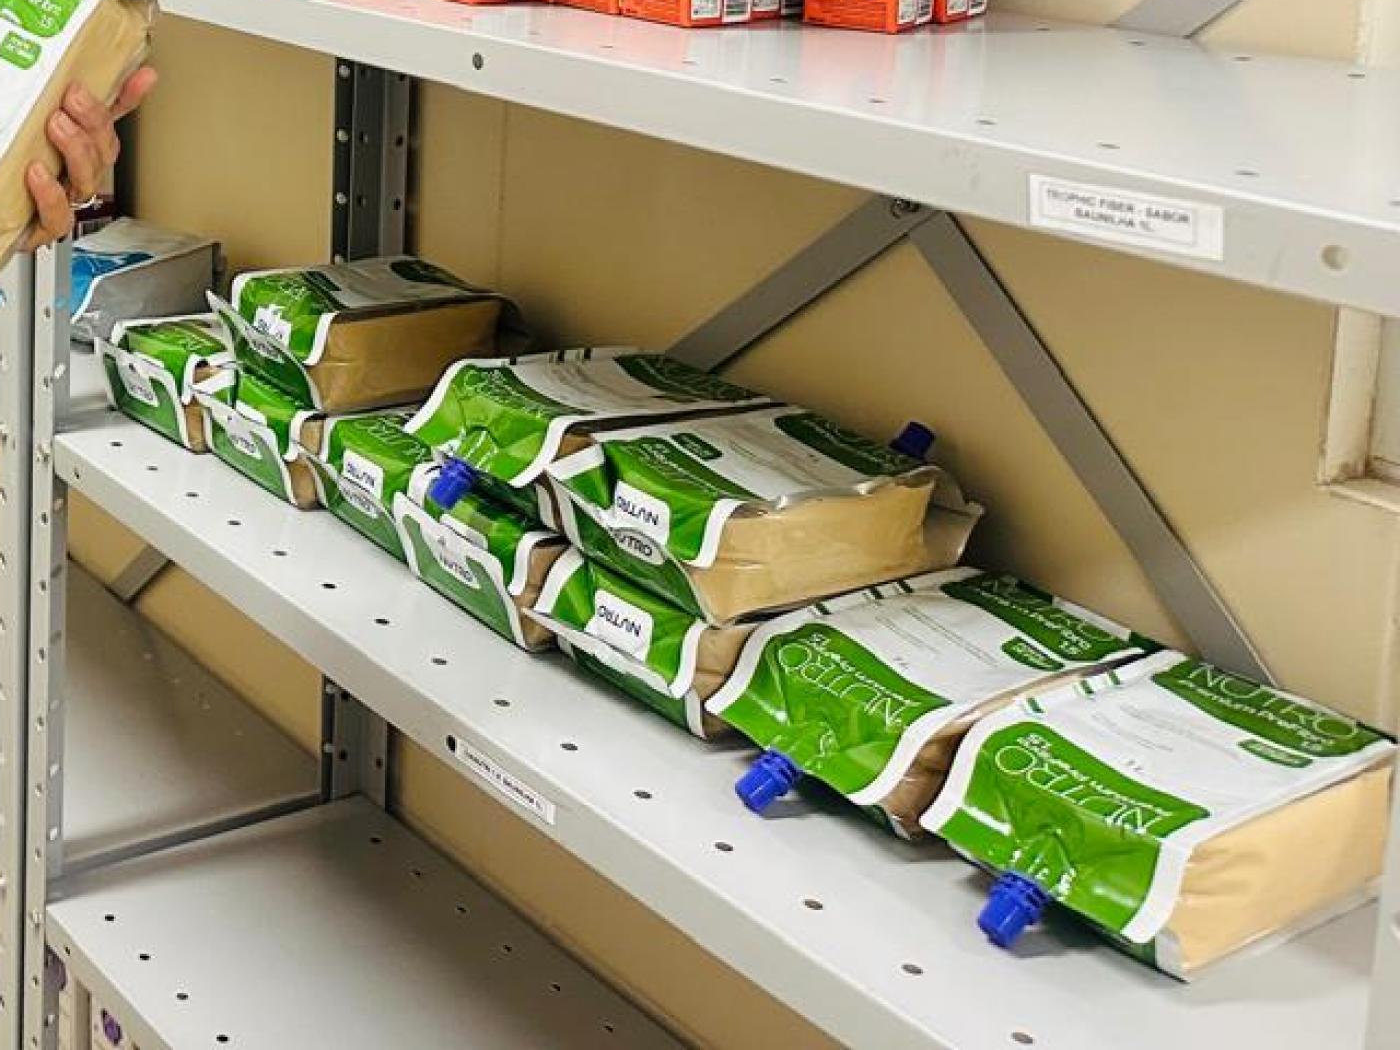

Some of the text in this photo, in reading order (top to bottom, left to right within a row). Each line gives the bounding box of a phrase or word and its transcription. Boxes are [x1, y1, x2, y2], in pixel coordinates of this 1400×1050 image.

[1145, 206, 1190, 224] SABOR
[1188, 662, 1358, 739] NUTRO
[994, 745, 1164, 834] NUTRO
